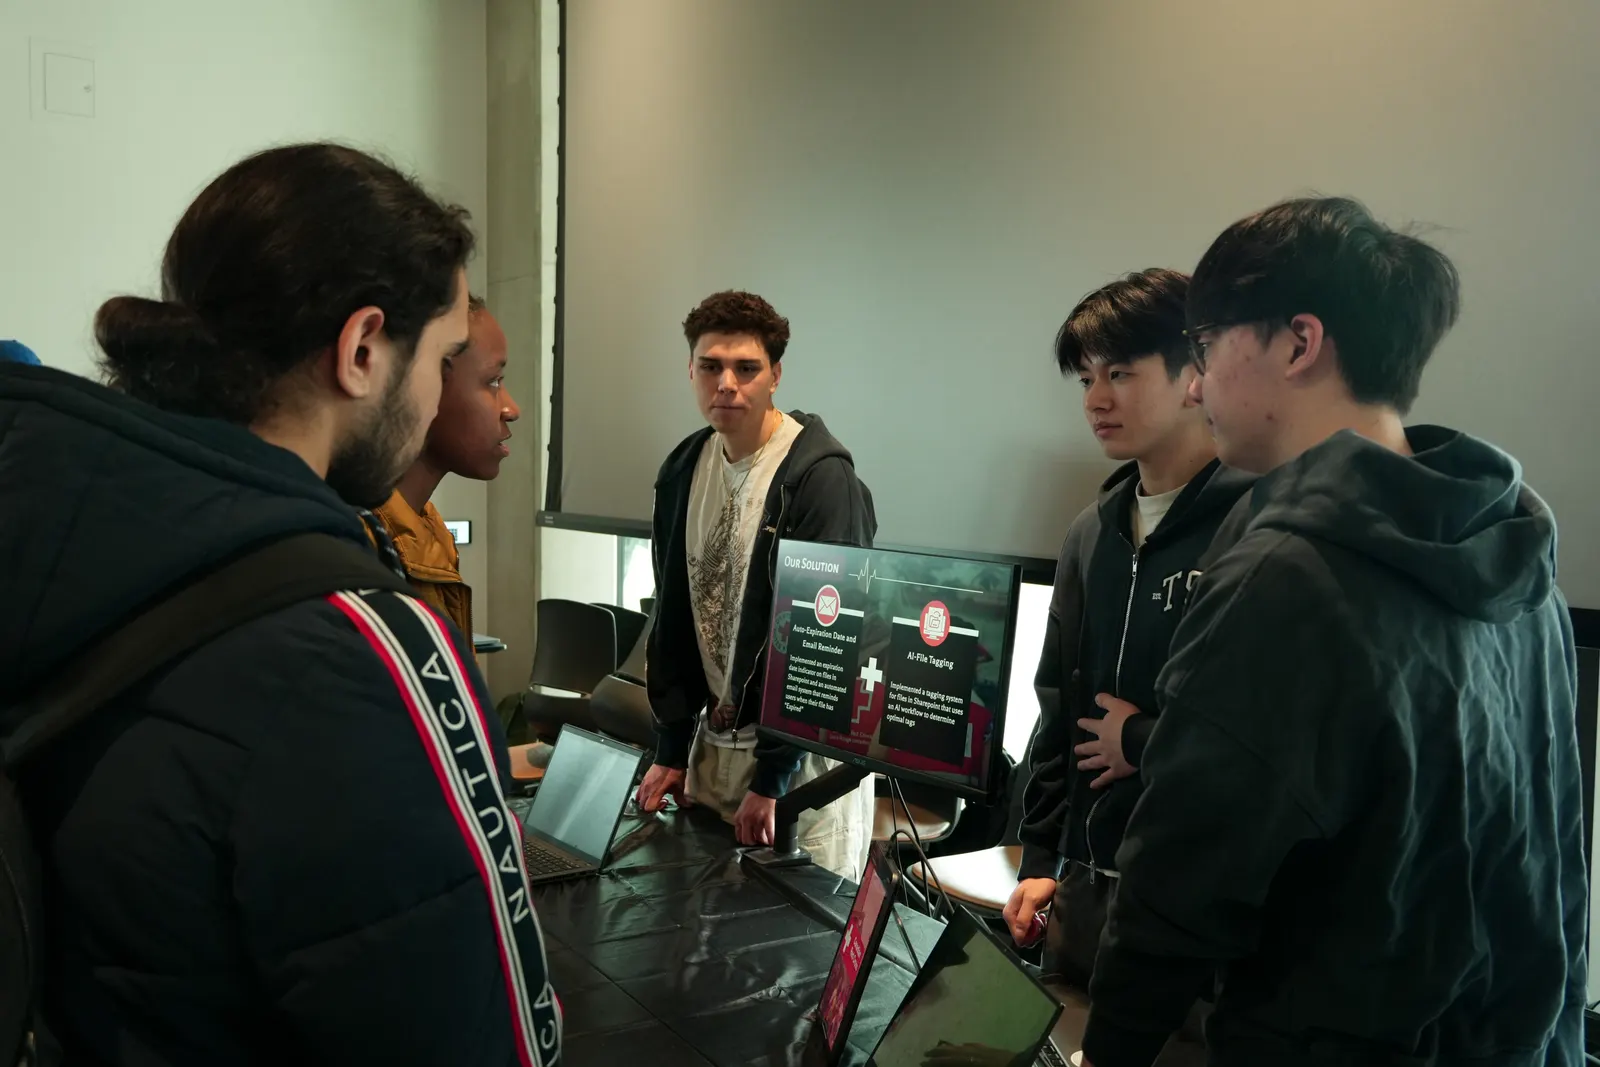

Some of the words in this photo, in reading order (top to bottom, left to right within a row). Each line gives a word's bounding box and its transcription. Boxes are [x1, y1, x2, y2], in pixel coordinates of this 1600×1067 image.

[792, 624, 832, 638] Auto-Expiration
[833, 631, 845, 641] Date
[846, 635, 857, 644] and
[802, 639, 817, 650] Email
[818, 643, 843, 655] Reminder
[790, 654, 816, 666] Implemented
[823, 663, 844, 672] expiration
[907, 651, 928, 663] AI-File
[929, 655, 954, 670] Tagging
[787, 673, 809, 684] Sharepoint
[824, 683, 847, 693] automated
[798, 666, 816, 676] indicator
[822, 671, 831, 680] files
[832, 673, 837, 681] in
[798, 687, 812, 695] system
[821, 693, 838, 702] reminds
[890, 681, 921, 693] Implemented
[926, 690, 945, 702] tagging
[945, 695, 964, 704] system
[797, 696, 807, 704] when
[808, 698, 818, 707] their
[826, 703, 834, 711] has
[897, 693, 907, 702] files
[913, 697, 941, 710] Sharepoint
[941, 704, 951, 713] that
[952, 708, 963, 716] uses
[886, 714, 904, 723] optimal
[905, 717, 915, 727] tags
[901, 706, 923, 717] workflow
[929, 713, 955, 725] determine
[421, 652, 529, 924] NAUTICA
